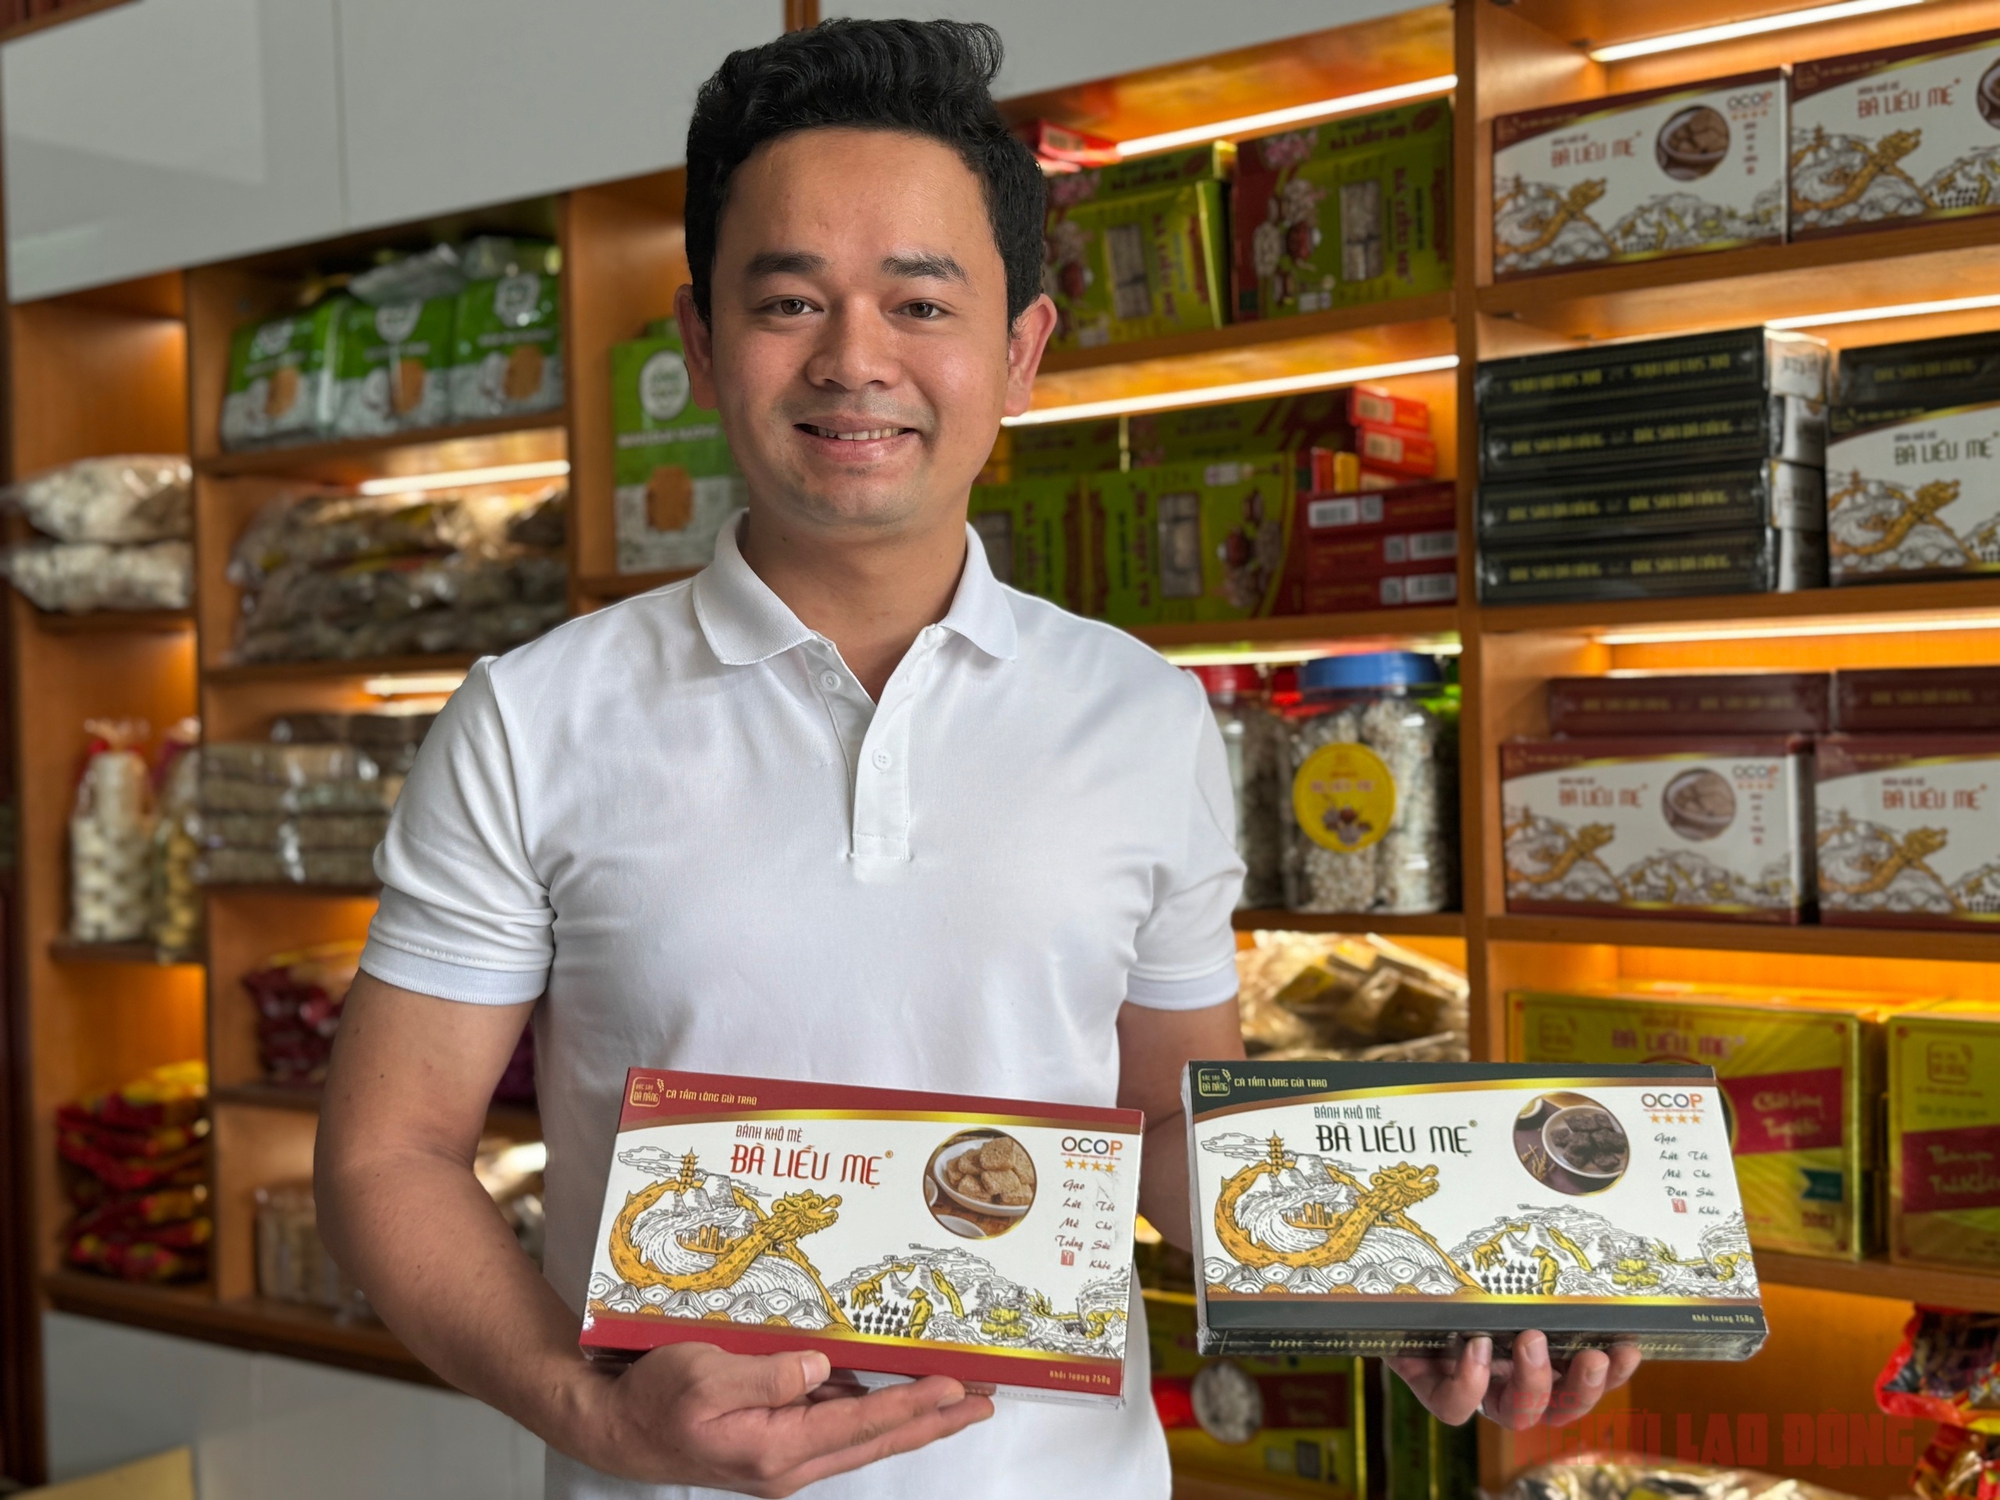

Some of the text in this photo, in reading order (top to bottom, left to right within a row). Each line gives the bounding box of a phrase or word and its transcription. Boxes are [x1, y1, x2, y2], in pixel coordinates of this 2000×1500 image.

[1641, 1093, 1703, 1109] OCOP
[1313, 1104, 1382, 1119] BÁNH KHÔ MÈ
[735, 1123, 803, 1143] BÁNH KHÔ MÈ
[1315, 1121, 1352, 1153] BÀ
[1429, 1126, 1472, 1157] MẸ
[1061, 1136, 1123, 1156] OCOP
[730, 1142, 766, 1176] BÀ
[840, 1153, 883, 1189] MẸ
[1062, 1179, 1085, 1192] Gạo
[1095, 1220, 1112, 1231] Cho
